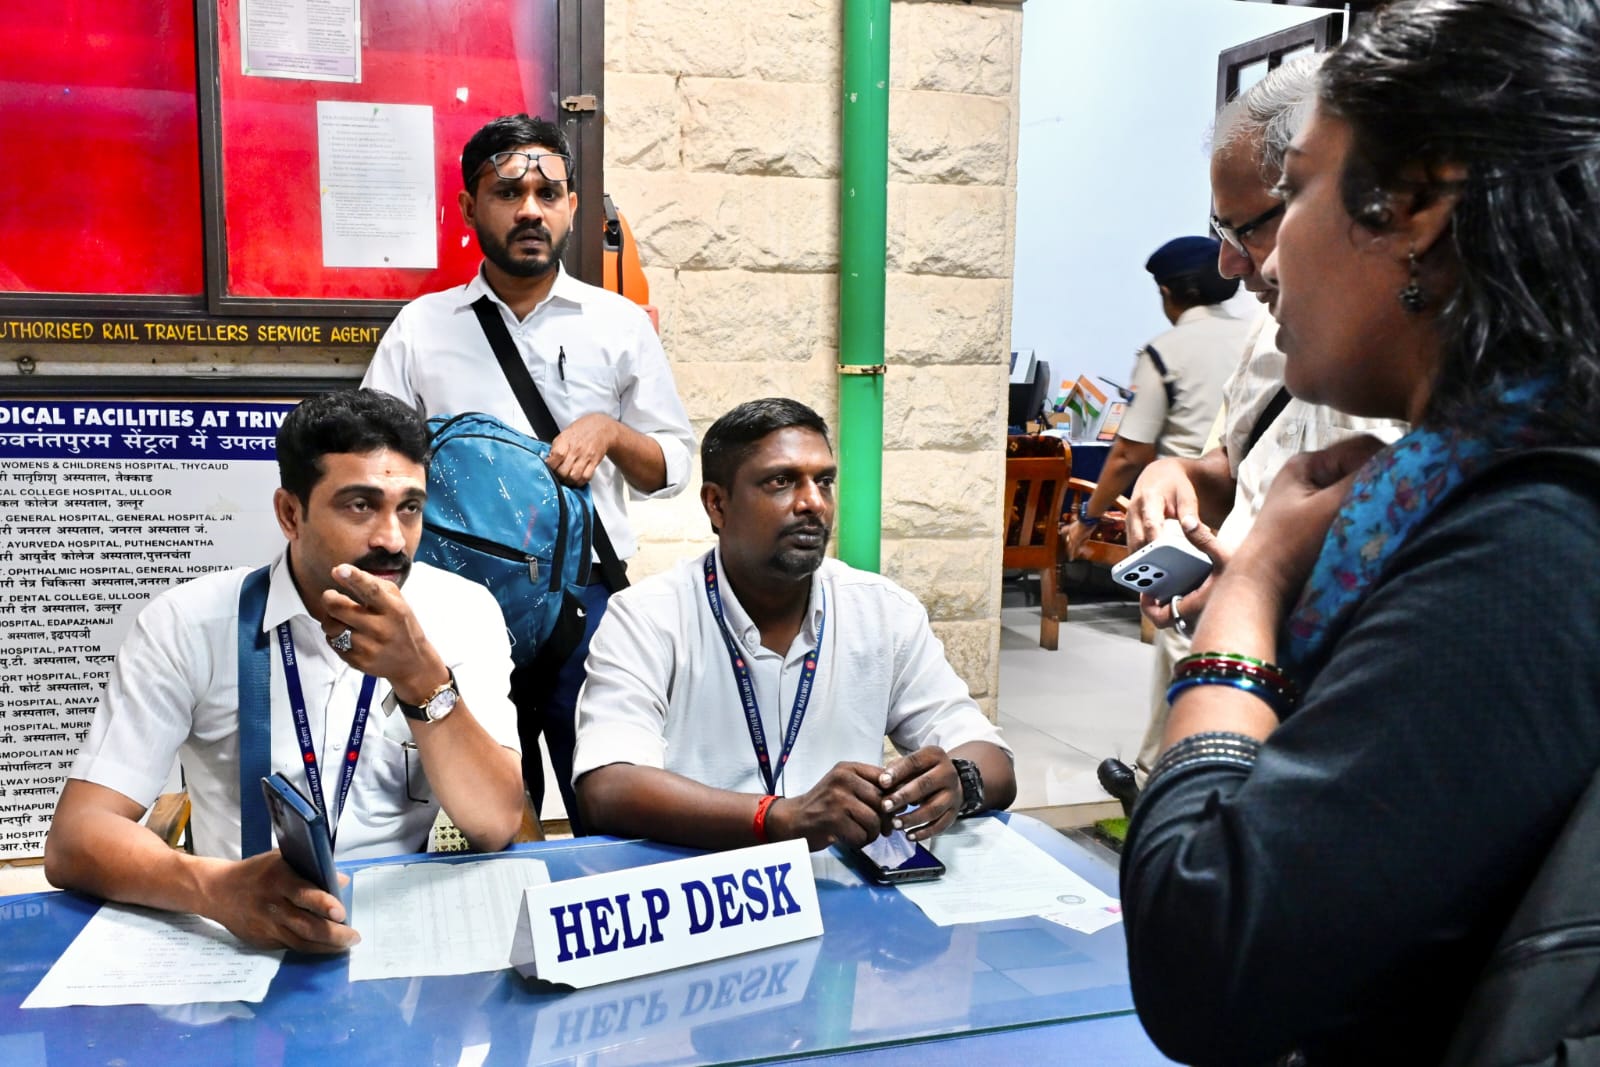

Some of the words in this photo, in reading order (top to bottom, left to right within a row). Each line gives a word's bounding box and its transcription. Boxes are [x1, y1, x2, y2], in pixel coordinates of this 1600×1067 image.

[102, 323, 139, 340] RAIL
[144, 323, 249, 342] TRAVELLERS
[257, 325, 321, 342] SERVICE
[330, 326, 380, 343] AGENT
[73, 407, 194, 427] FACILITIES
[201, 410, 229, 427] AT
[121, 428, 179, 454] सेंट्रल
[188, 429, 208, 449] में
[1, 461, 49, 469] WOMENS
[53, 461, 59, 469] &
[62, 461, 121, 469] CHILDRENS
[125, 462, 178, 471] HOSPITAL,
[181, 462, 229, 470] THYCAUD
[20, 488, 70, 496] COLLEGE
[73, 488, 127, 497] HOSPITAL,
[130, 488, 172, 496] ULLOOR
[5, 514, 56, 522] GENERAL
[59, 514, 113, 523] HOSPITAL,
[7, 540, 65, 548] AYURVEDA
[68, 540, 122, 549] HOSPITAL,
[8, 567, 77, 576] OPHTHALMIC
[80, 566, 133, 575] HOSPITAL,
[136, 566, 184, 574] GENERAL
[187, 565, 233, 574] HOSPITA
[9, 594, 52, 602] DENTAL
[54, 594, 106, 602] COLLEGE,
[108, 593, 150, 601] ULLOOR
[47, 617, 114, 626] EDAPAZHANJI
[0, 646, 55, 655] HOSPITAL,
[58, 645, 101, 653] PATTOM
[26, 673, 80, 681] HOSPITAL,
[83, 671, 110, 679] FORT
[742, 678, 754, 707] RAILWAY
[797, 679, 810, 709] RAILWAY
[8, 698, 62, 707] HOSPITAL,
[4, 722, 58, 731] HOSPITAL,
[748, 708, 763, 745] SOUTHERN
[550, 887, 671, 962] HELP
[681, 862, 801, 935] DESK
